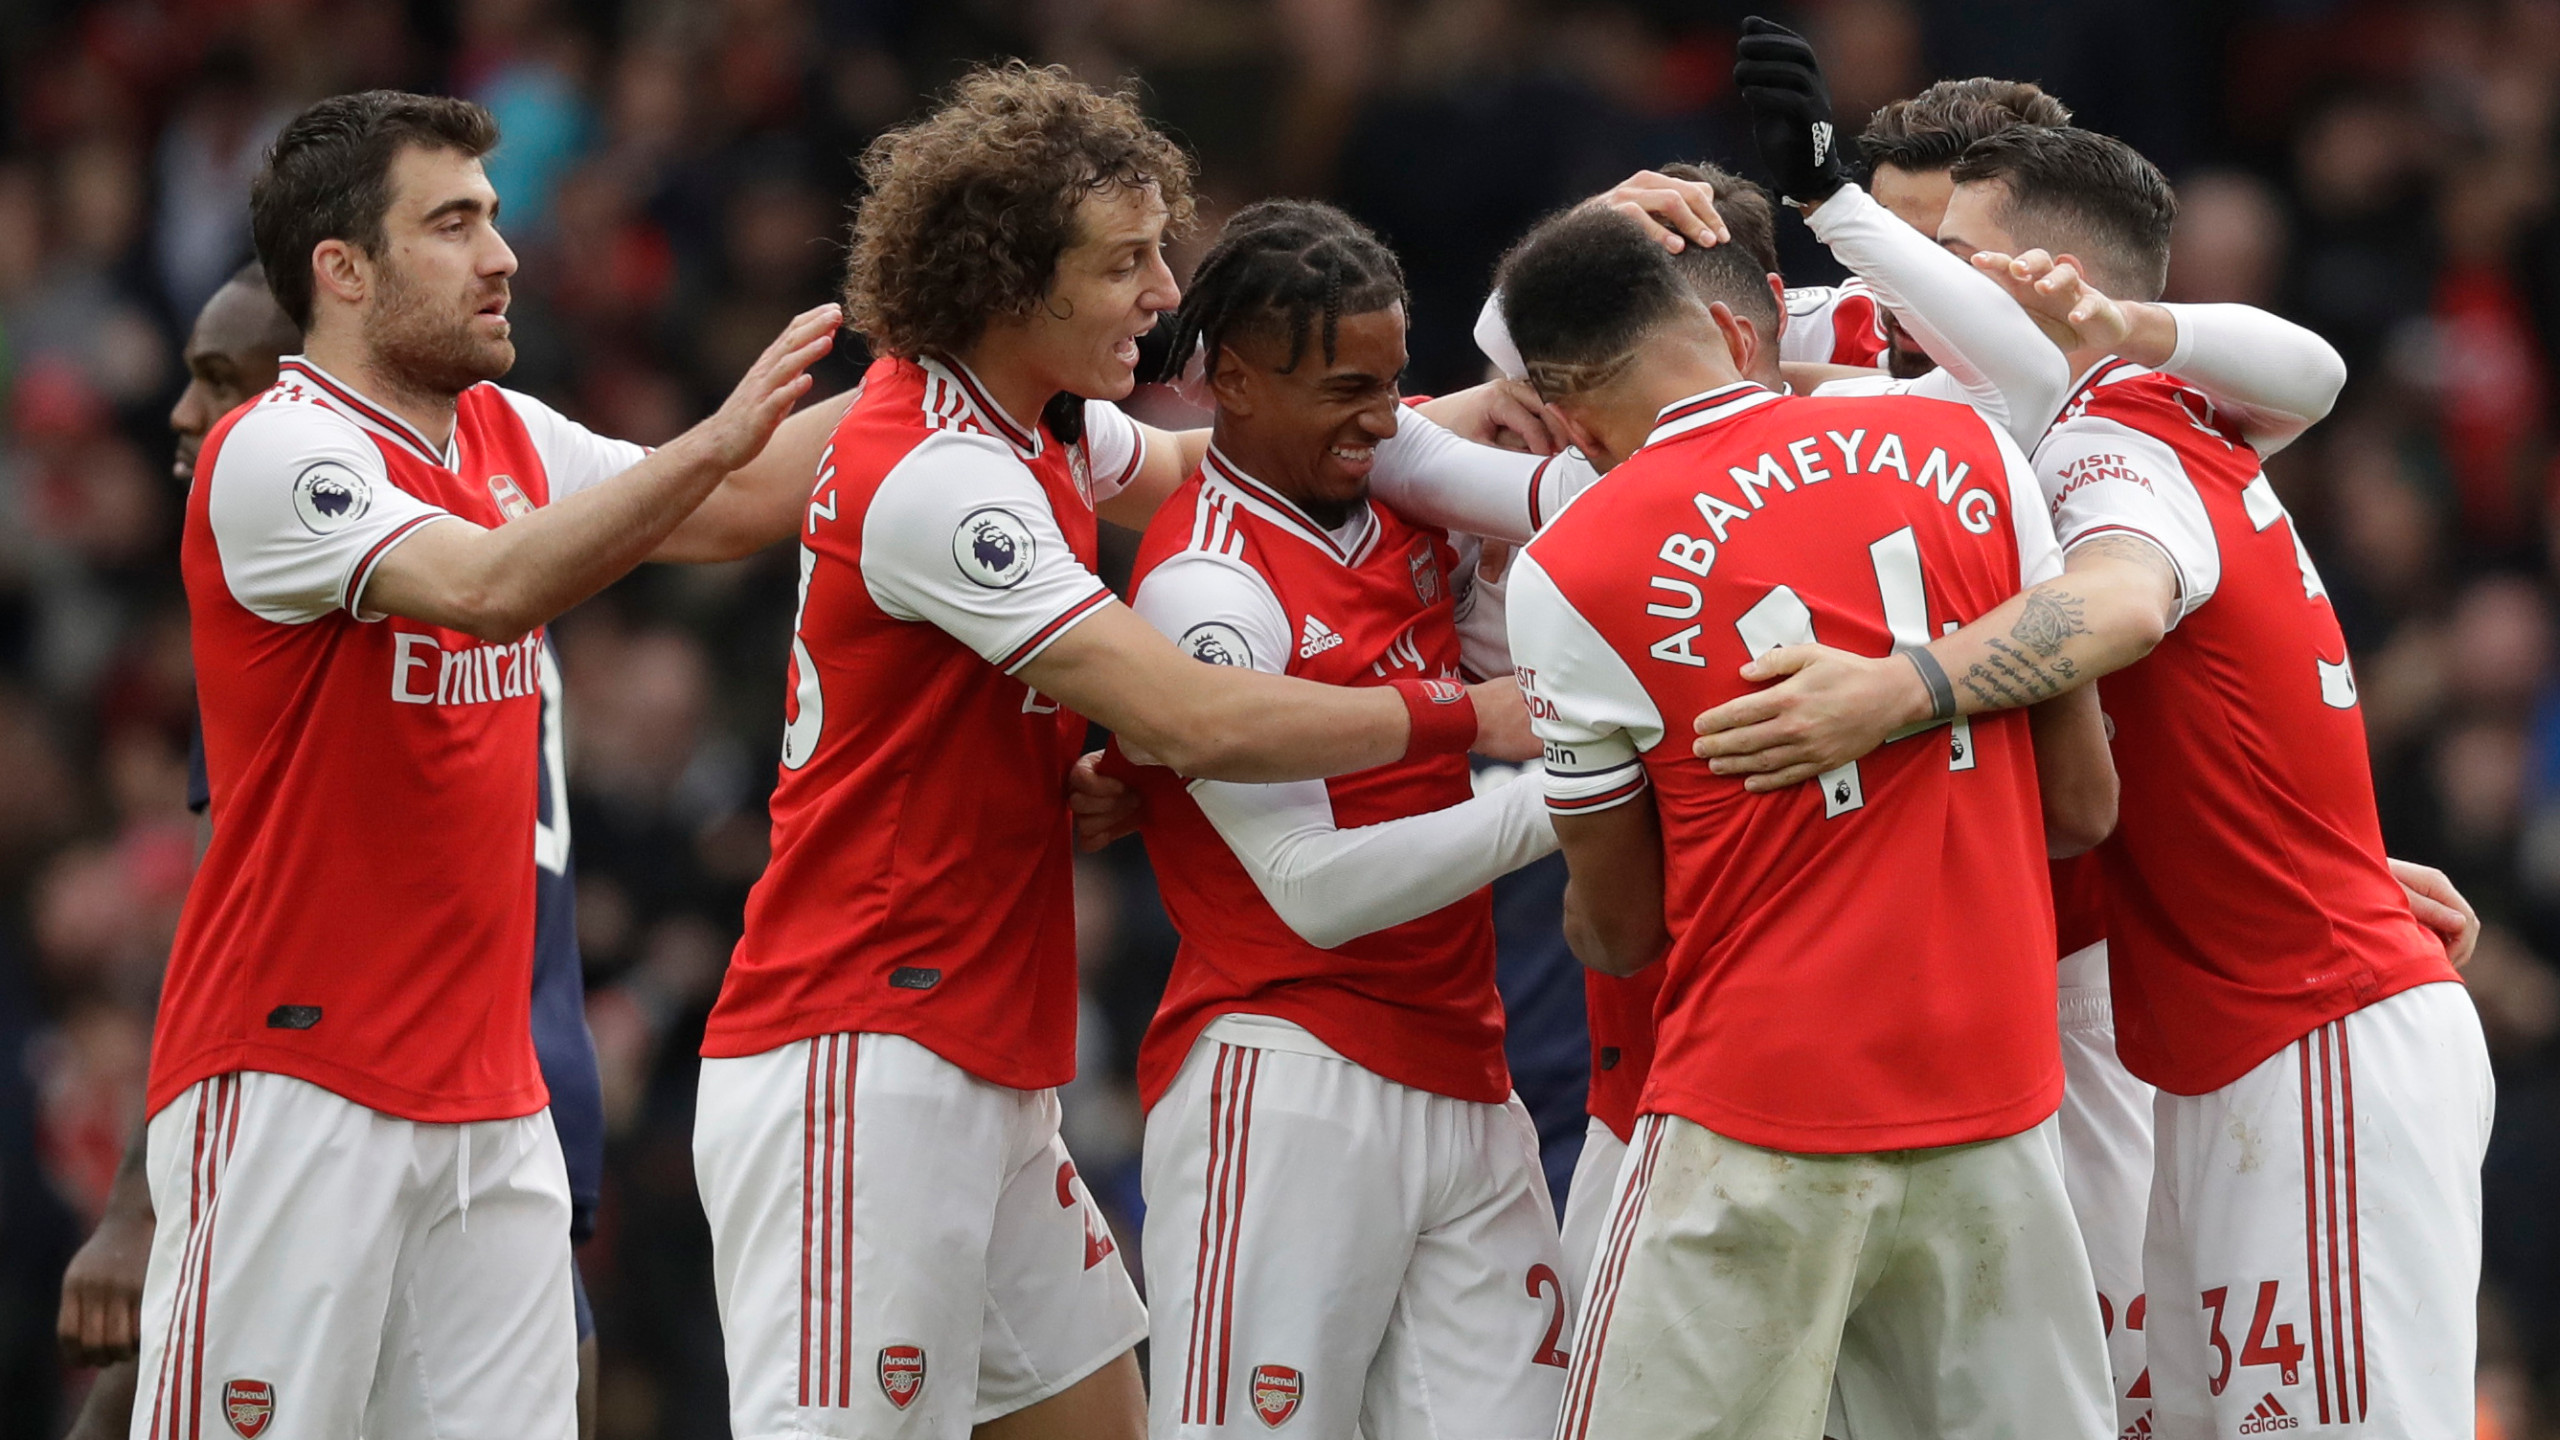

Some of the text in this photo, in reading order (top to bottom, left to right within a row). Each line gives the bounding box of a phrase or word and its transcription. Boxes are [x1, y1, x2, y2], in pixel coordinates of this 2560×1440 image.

[2056, 454, 2127, 479] VISIT
[2051, 466, 2156, 520] RWANDA
[1646, 428, 1997, 668] AUBAMEYANG
[1300, 633, 1344, 659] adidas
[2200, 1280, 2306, 1397] 34
[885, 1355, 920, 1365] Arsenal
[1258, 1373, 1297, 1387] Arsenal
[229, 1388, 269, 1400] Arsenal
[2239, 1417, 2299, 1435] adidas
